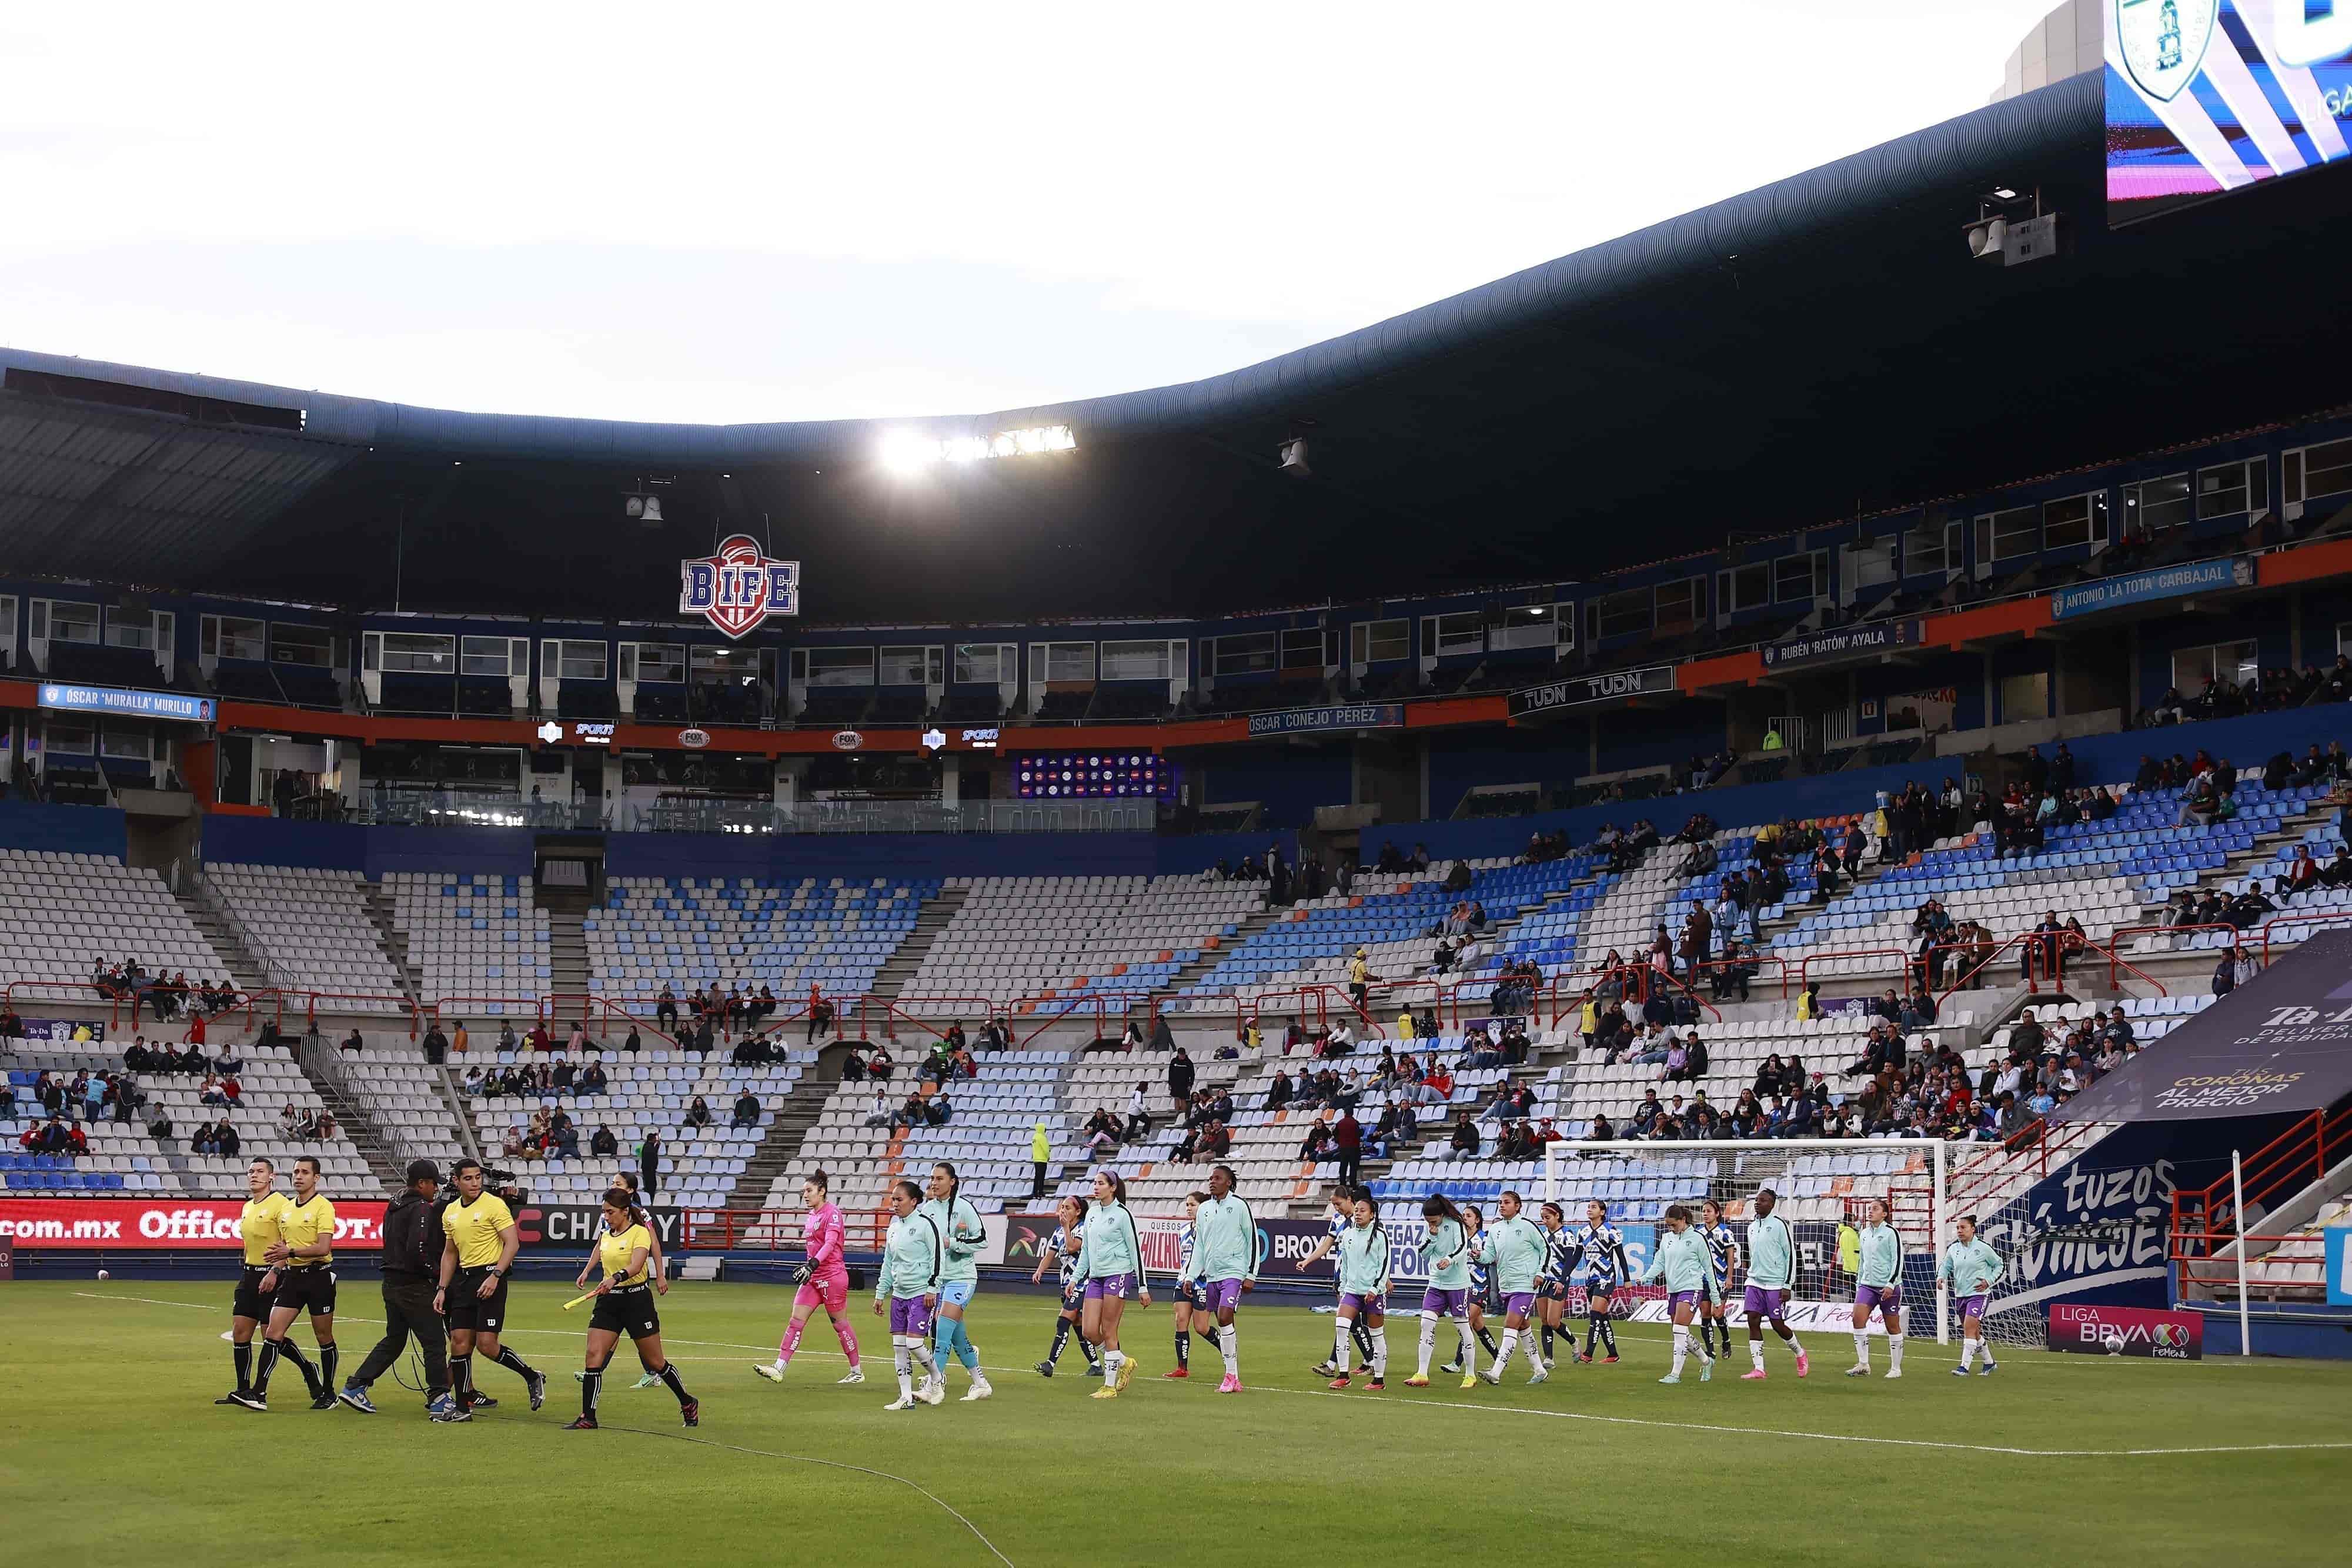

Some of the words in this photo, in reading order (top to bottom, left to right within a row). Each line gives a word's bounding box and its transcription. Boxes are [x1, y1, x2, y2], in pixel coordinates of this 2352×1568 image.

[686, 562, 795, 612] BIFE
[2066, 588, 2105, 609] ANTONIO
[2159, 567, 2226, 589] CARBAJAL
[1780, 641, 1809, 660] RUBÉN
[1852, 630, 1885, 647] AYALA
[1525, 685, 1566, 708] TUDN
[1588, 673, 1642, 697] TUDN
[66, 689, 98, 704] ÓSCAR
[154, 698, 192, 714] MURILLO
[1249, 715, 1280, 732] ÓSCAR
[1336, 707, 1376, 723] PÉREZ
[576, 723, 614, 735] SPORTS
[962, 729, 999, 741] SPORTS
[685, 733, 703, 741] FOX
[2259, 1025, 2352, 1036] DELIVER
[2174, 1072, 2306, 1086] CORONAS
[2154, 1088, 2191, 1098] AL
[2196, 1084, 2290, 1098] MEJOR
[2156, 1095, 2259, 1108] PRECIO
[1151, 1222, 1181, 1231] QUESOS
[2061, 1307, 2100, 1322] LIGA
[2080, 1323, 2151, 1343] BBVA
